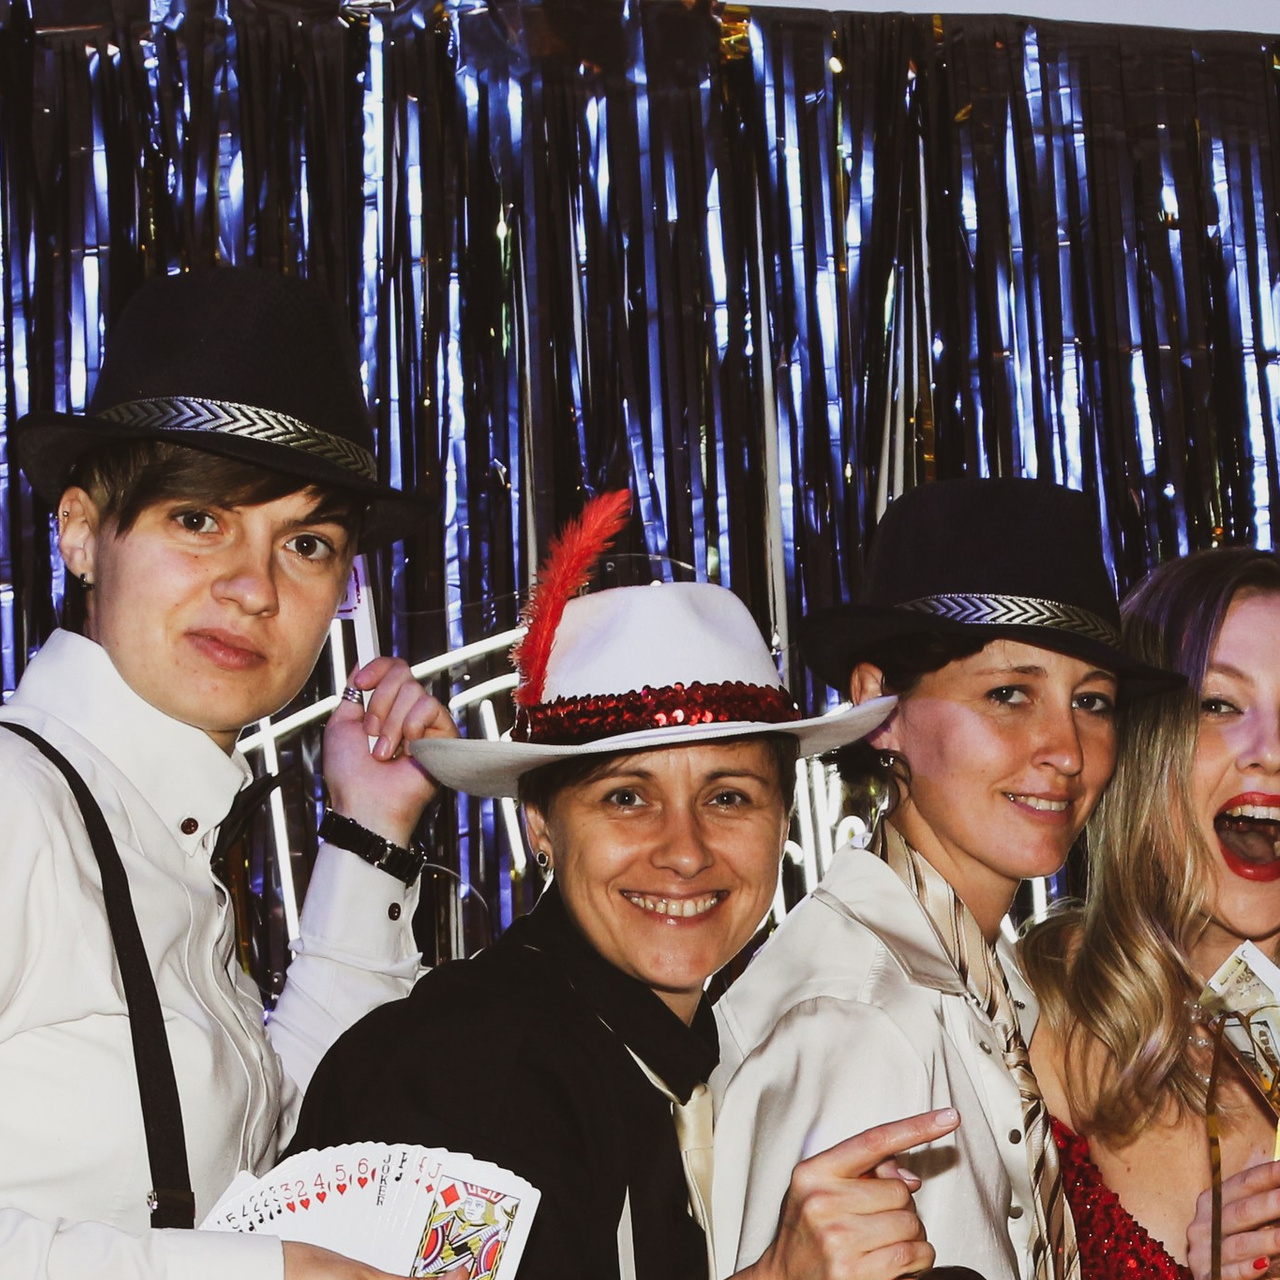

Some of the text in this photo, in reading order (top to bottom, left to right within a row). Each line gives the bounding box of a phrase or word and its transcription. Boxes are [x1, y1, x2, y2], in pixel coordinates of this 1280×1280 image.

[335, 1164, 347, 1182] 5
[357, 1158, 369, 1175] 6
[428, 1162, 442, 1179] J
[314, 1173, 325, 1189] 4
[376, 1154, 392, 1206] JOKER
[295, 1180, 308, 1198] 2
